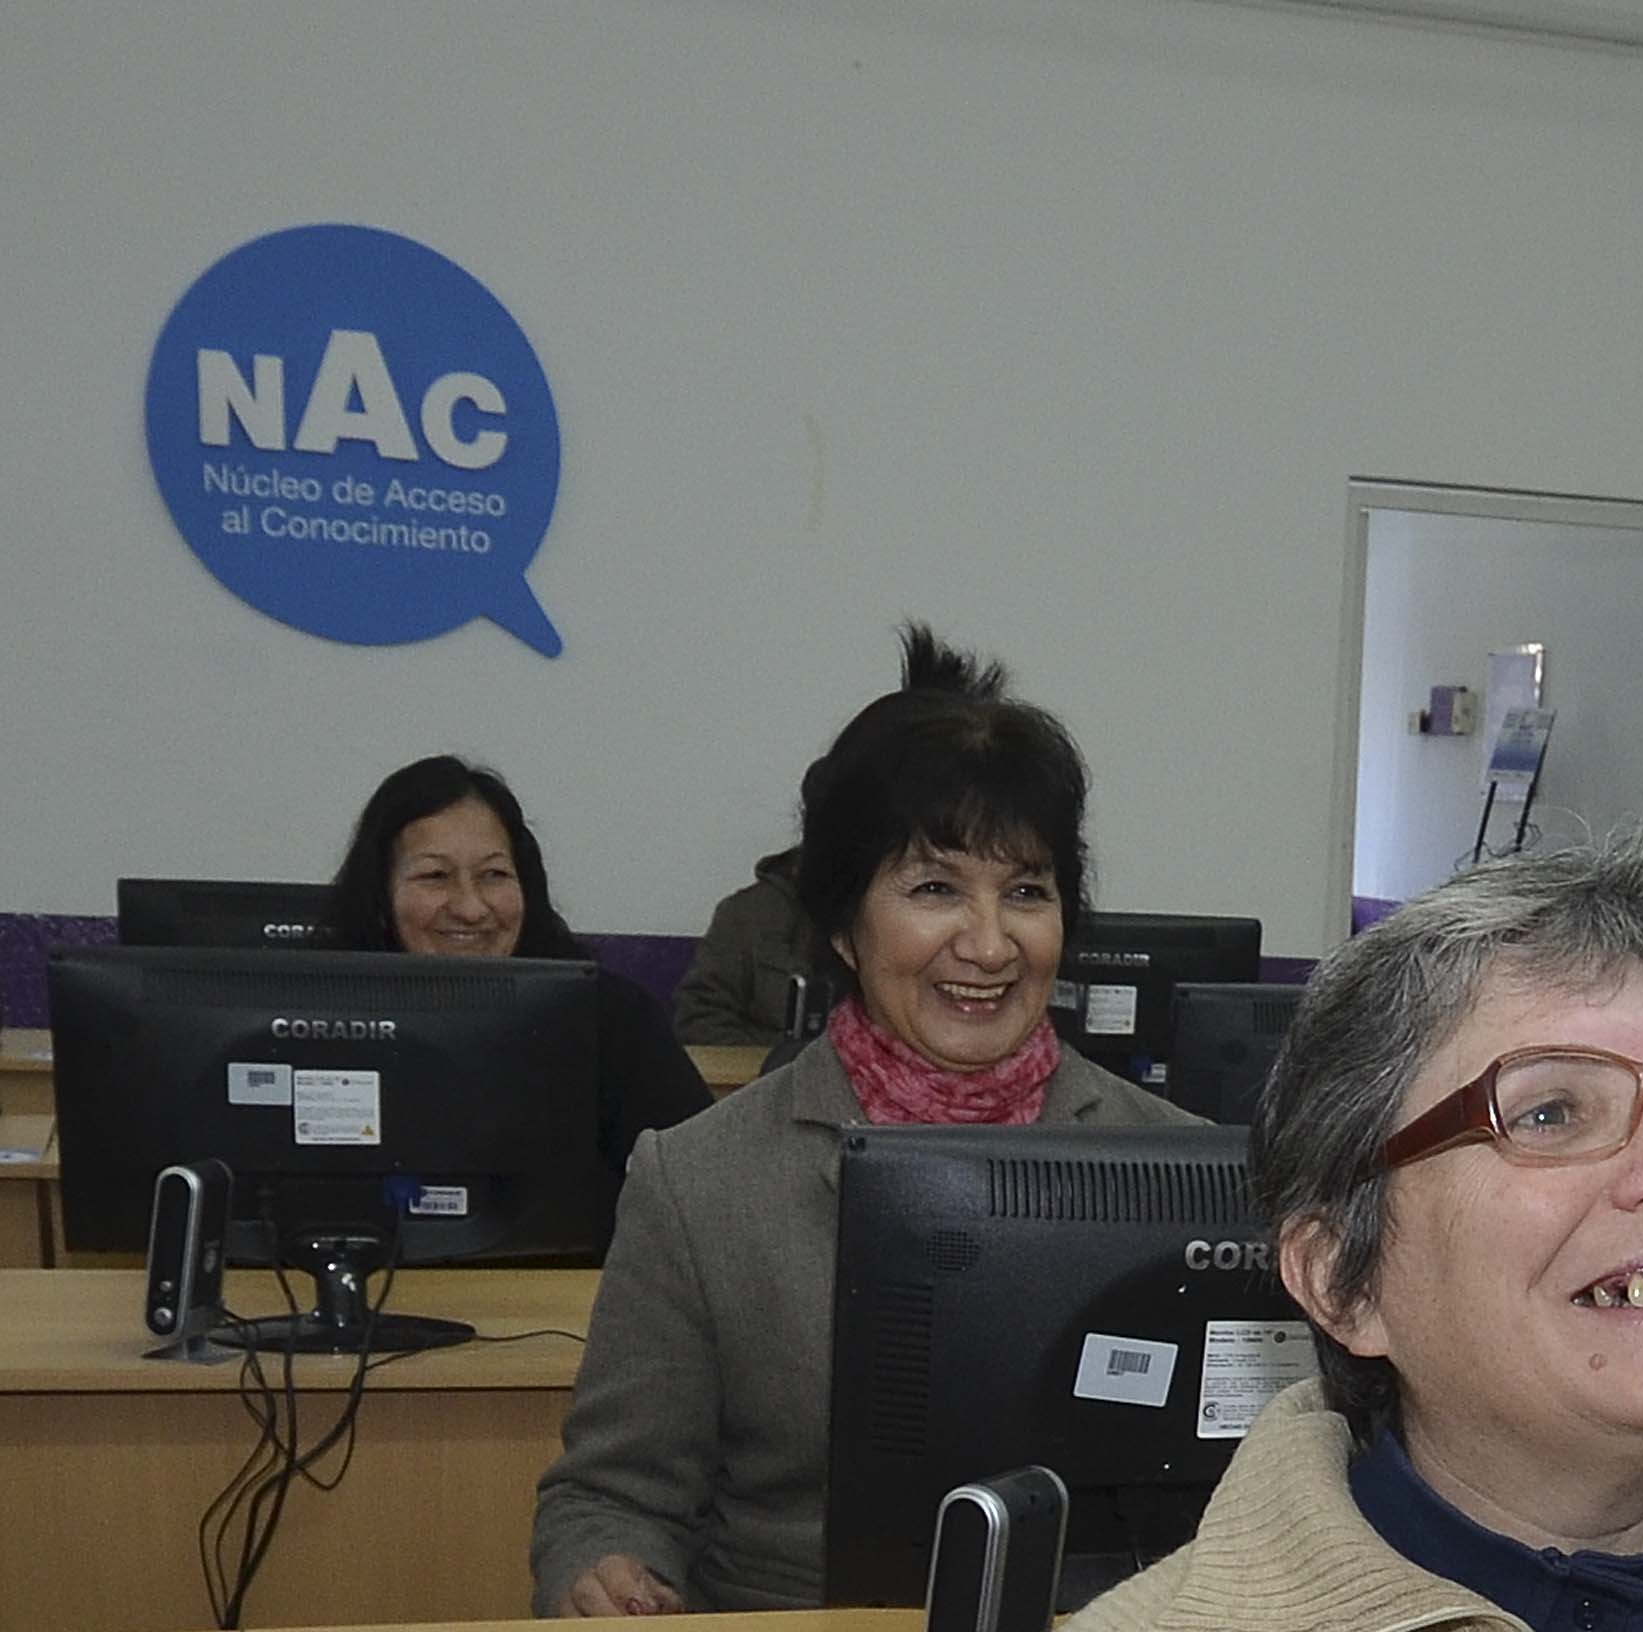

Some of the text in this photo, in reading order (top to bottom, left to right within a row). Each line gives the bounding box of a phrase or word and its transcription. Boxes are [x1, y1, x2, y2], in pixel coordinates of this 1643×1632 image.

[197, 329, 507, 470] NAC
[202, 462, 507, 517] Núcleo de Acceso
[222, 507, 491, 553] al Conocimiento
[271, 1017, 397, 1041] CORADIR
